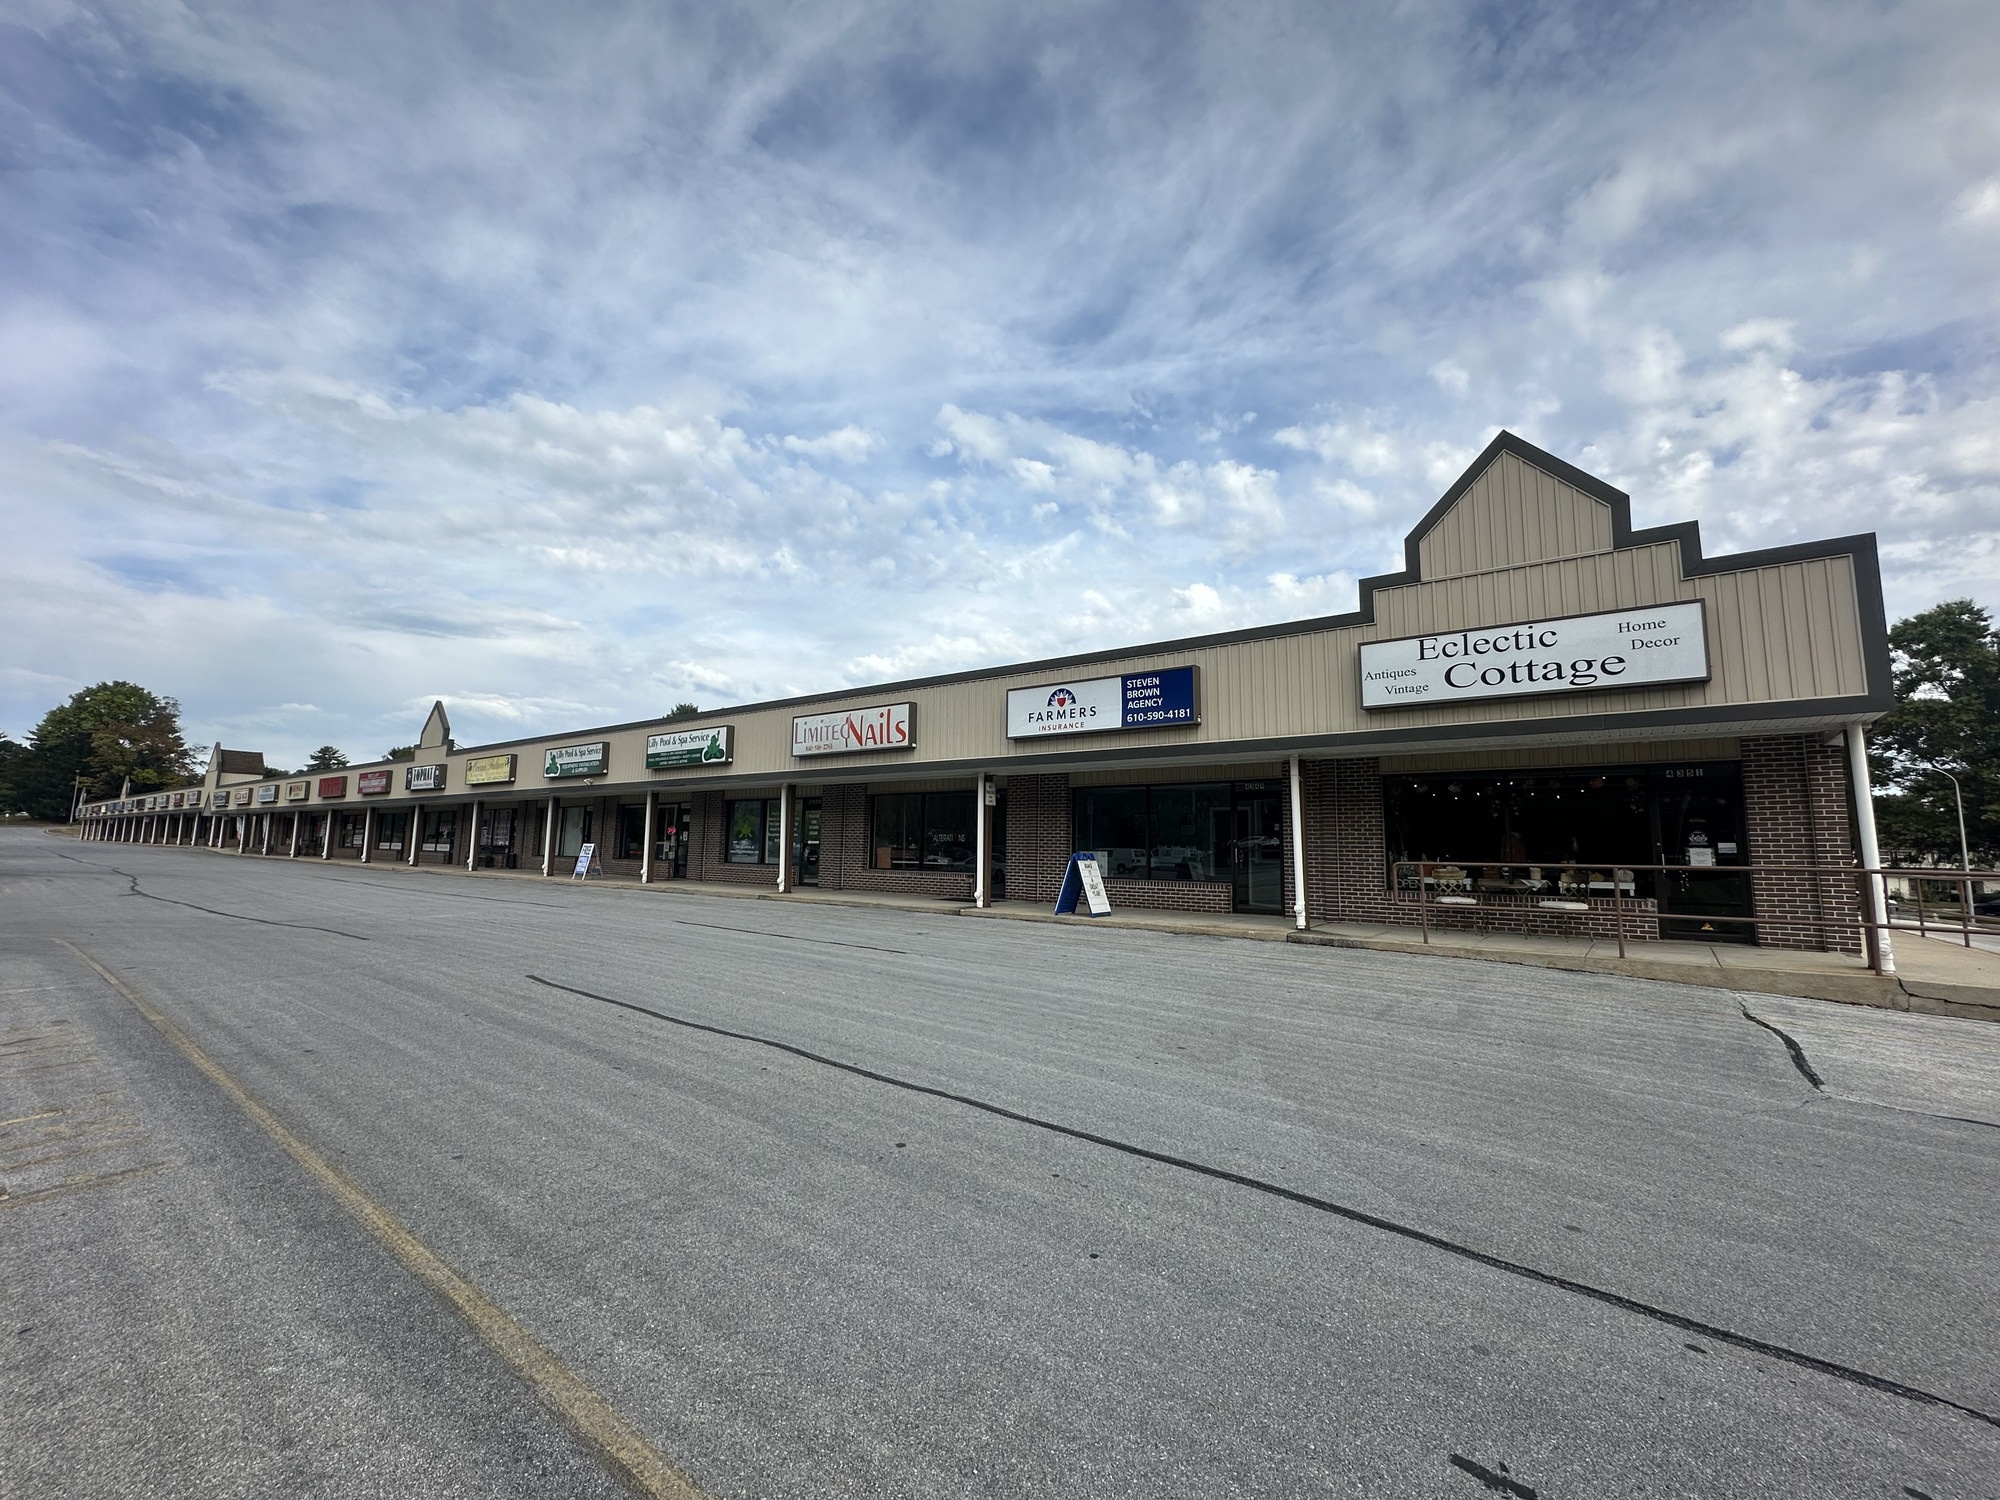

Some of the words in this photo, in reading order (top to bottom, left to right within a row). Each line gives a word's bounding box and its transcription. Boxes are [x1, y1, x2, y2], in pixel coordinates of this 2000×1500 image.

[1618, 618, 1667, 634] Home
[1416, 624, 1558, 661] Eclectic
[1631, 635, 1680, 650] Decor
[1364, 666, 1417, 682] Antiques
[1443, 655, 1627, 689] Cottage
[1126, 676, 1160, 689] STEVEN
[1384, 682, 1429, 696] Vintage
[1126, 687, 1160, 699] BROWN
[1127, 698, 1163, 710] AGENCY
[1028, 706, 1097, 723] FARMERS
[1126, 708, 1191, 723] 610-590-4181
[1038, 721, 1085, 732] INSURANCE
[648, 737, 659, 750] Lilly
[659, 736, 672, 747] Pool
[671, 737, 677, 745] &
[677, 735, 688, 748] Spa
[688, 732, 710, 743] Service
[564, 749, 574, 758] Pool
[578, 748, 586, 758] Spa
[586, 745, 602, 756] Service
[1665, 769, 1704, 778] 4351
[933, 833, 966, 842] ALTERATINS
